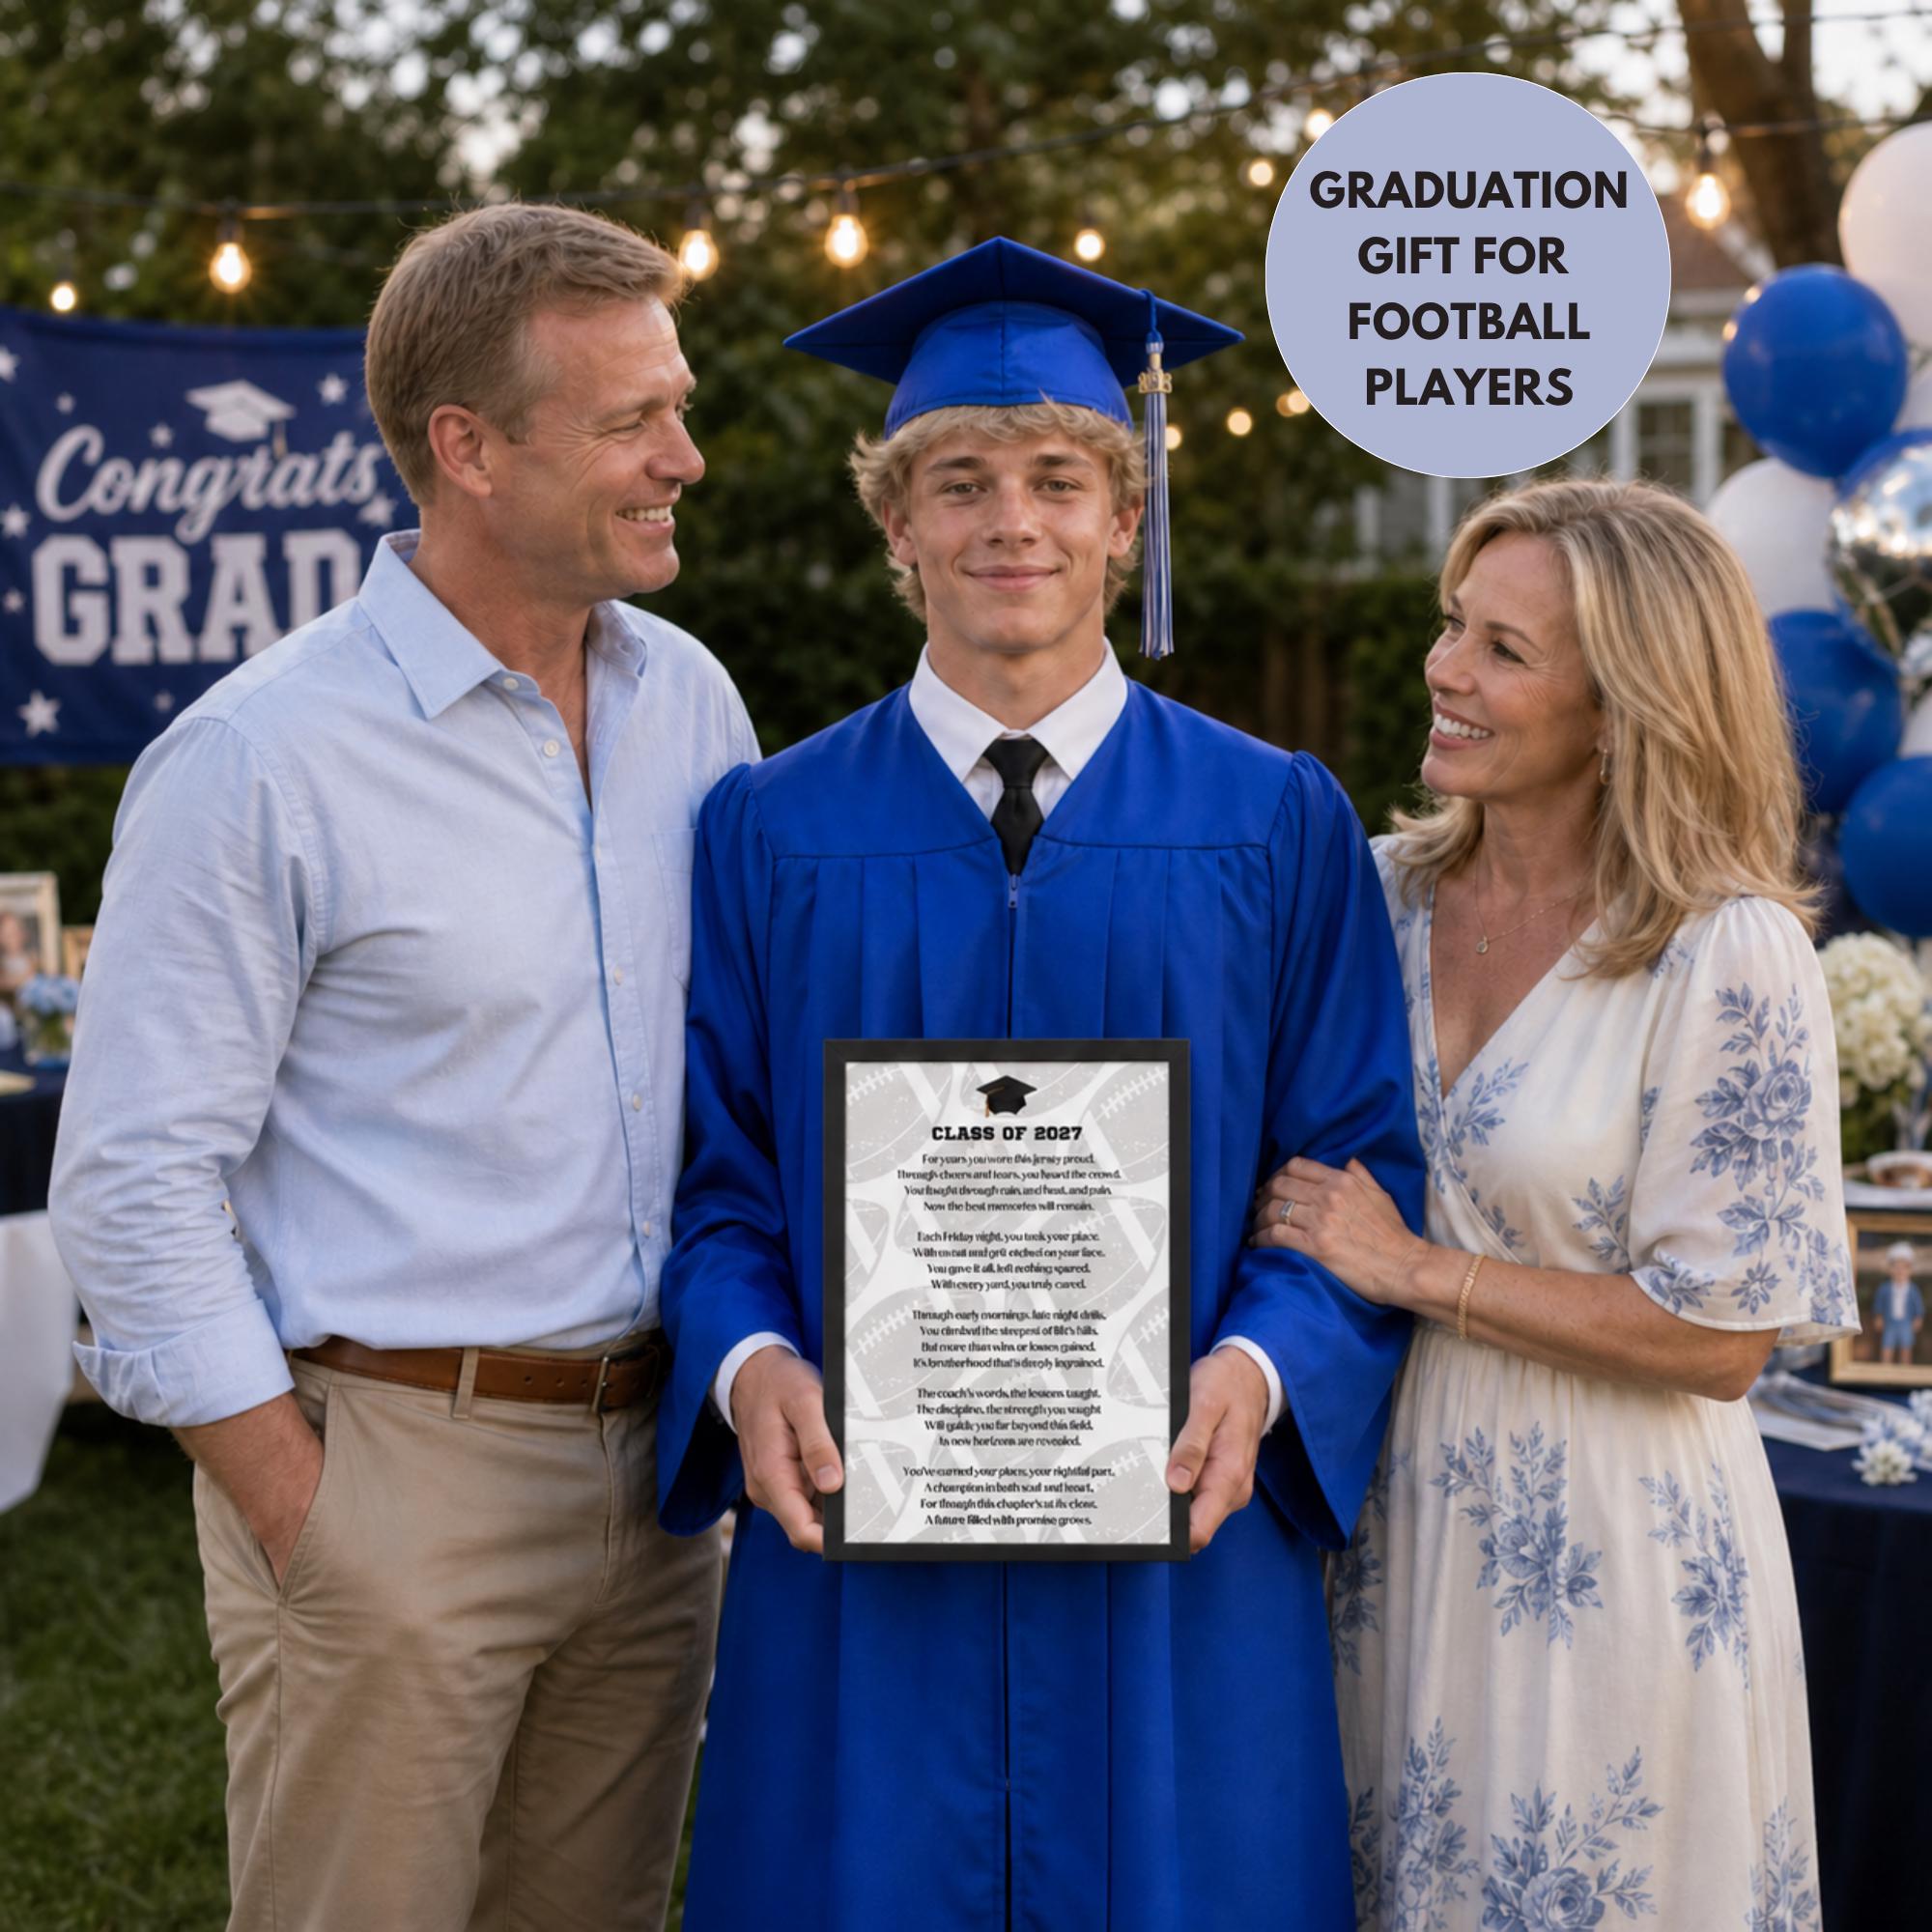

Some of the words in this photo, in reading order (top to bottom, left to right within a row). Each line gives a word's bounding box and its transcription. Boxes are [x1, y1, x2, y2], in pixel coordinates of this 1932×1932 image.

[36, 424, 384, 545] Congrats
[32, 527, 361, 667] GRAD
[931, 1126, 995, 1141] CLASS
[1002, 1126, 1028, 1141] OF
[1034, 1126, 1082, 1141] 2027
[948, 1202, 963, 1210] the
[917, 1388, 936, 1398] The
